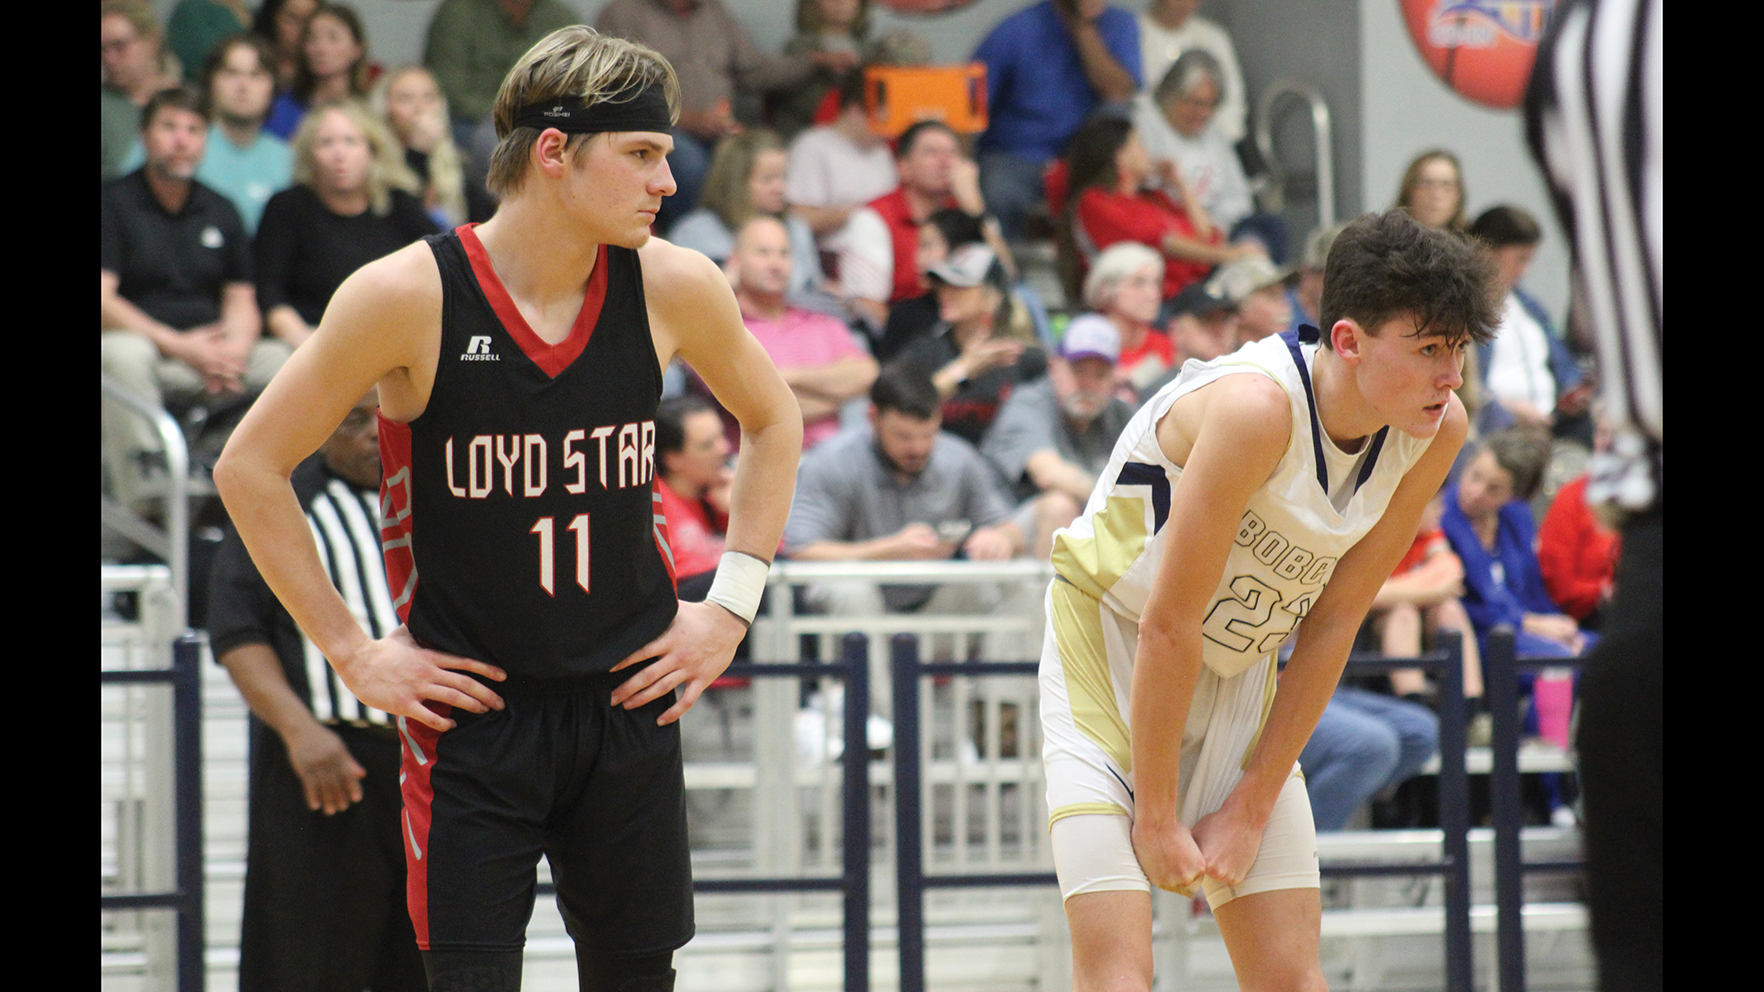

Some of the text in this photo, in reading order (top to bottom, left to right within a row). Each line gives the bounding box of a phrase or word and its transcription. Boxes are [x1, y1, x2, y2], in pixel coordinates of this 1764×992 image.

[460, 353, 501, 361] RUSSELL
[445, 420, 656, 499] LOYD STAR
[529, 512, 590, 598] 11
